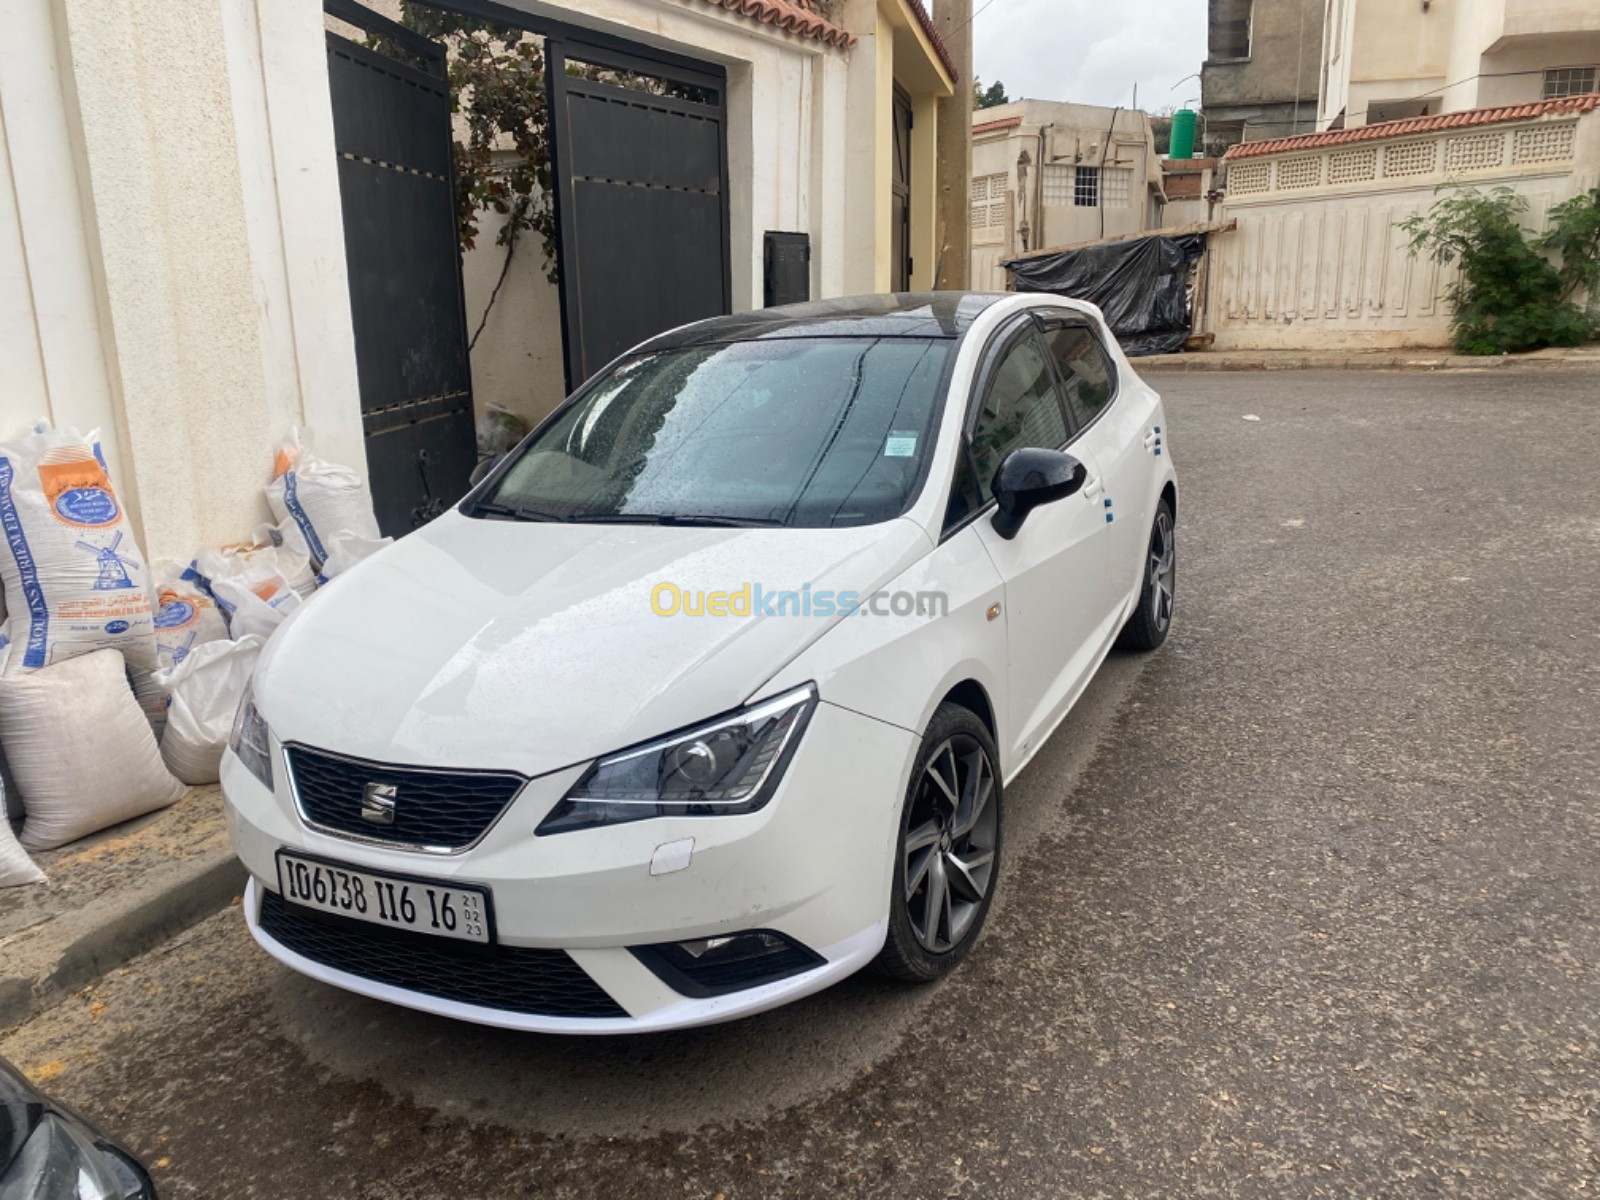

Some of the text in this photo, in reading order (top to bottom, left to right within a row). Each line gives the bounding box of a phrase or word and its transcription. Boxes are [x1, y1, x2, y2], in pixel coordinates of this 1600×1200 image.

[374, 881, 416, 923] 116
[427, 889, 456, 931] 16
[462, 895, 477, 907] 21
[464, 910, 480, 922] 02
[466, 924, 482, 936] 23
